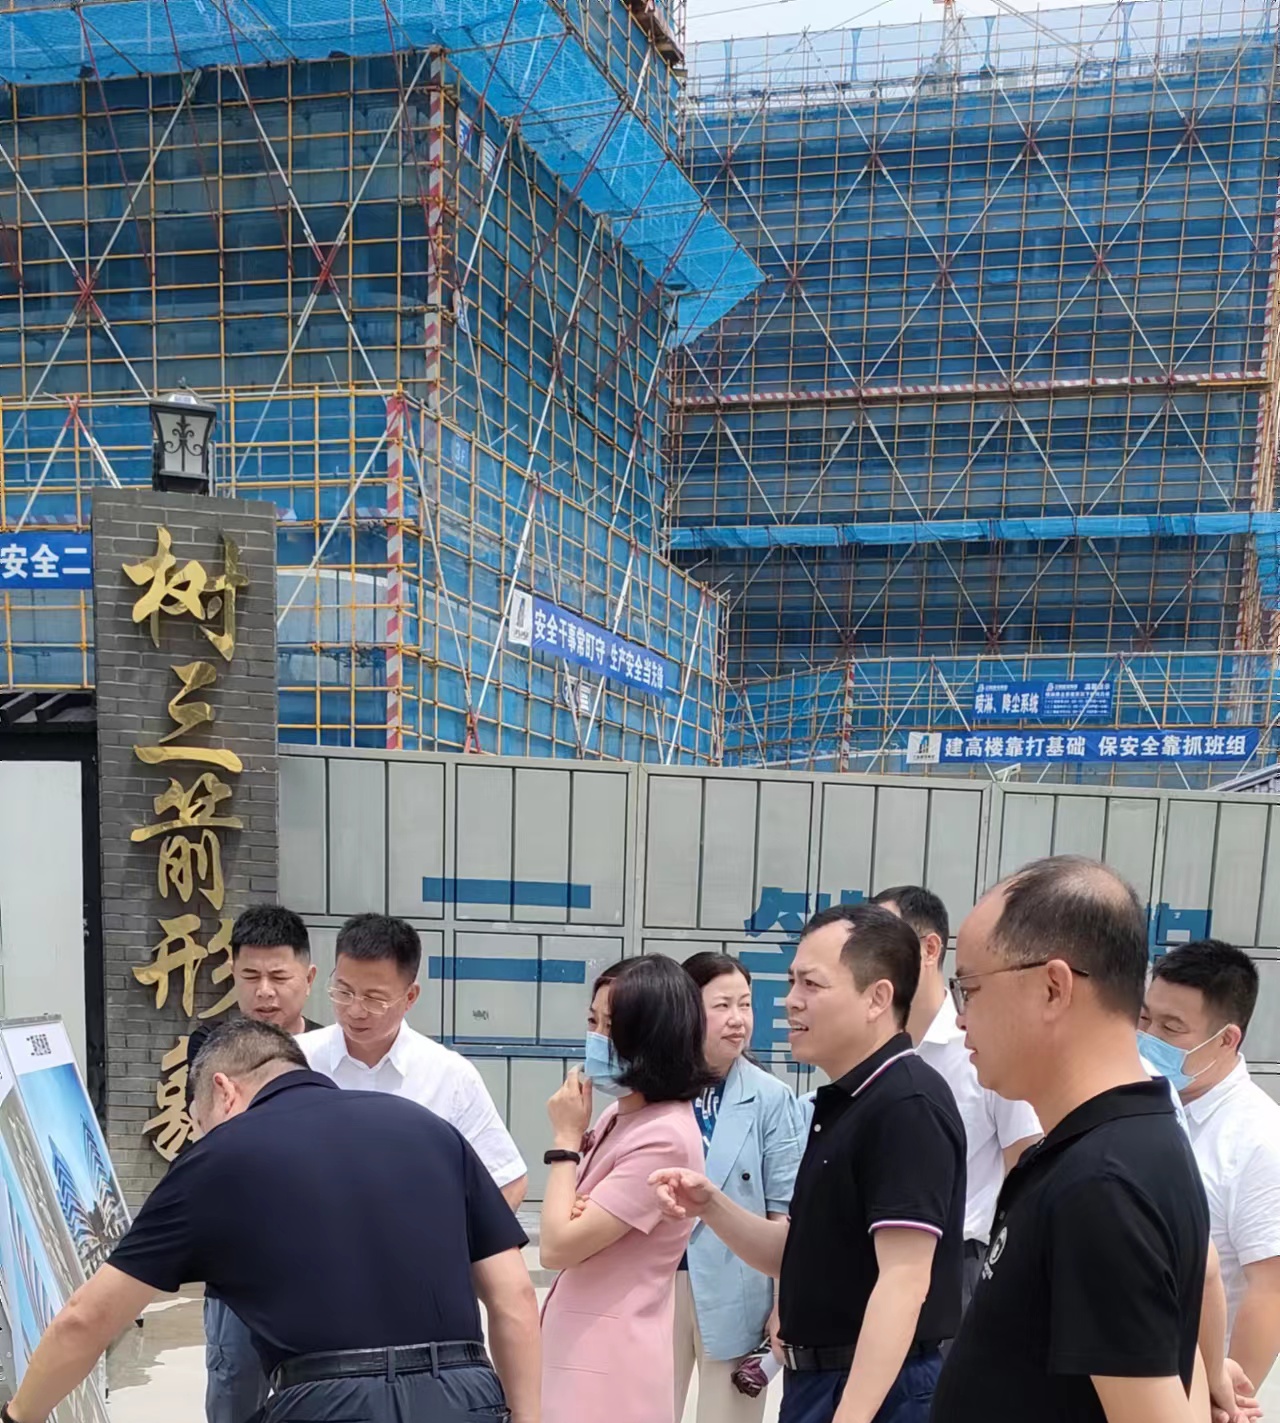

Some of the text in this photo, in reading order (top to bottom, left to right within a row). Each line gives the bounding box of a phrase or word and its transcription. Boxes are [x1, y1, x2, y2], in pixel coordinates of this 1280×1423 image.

[0, 543, 91, 579] 安全二
[945, 735, 1246, 757] 建高楼靠打基础 保安全靠抓班组
